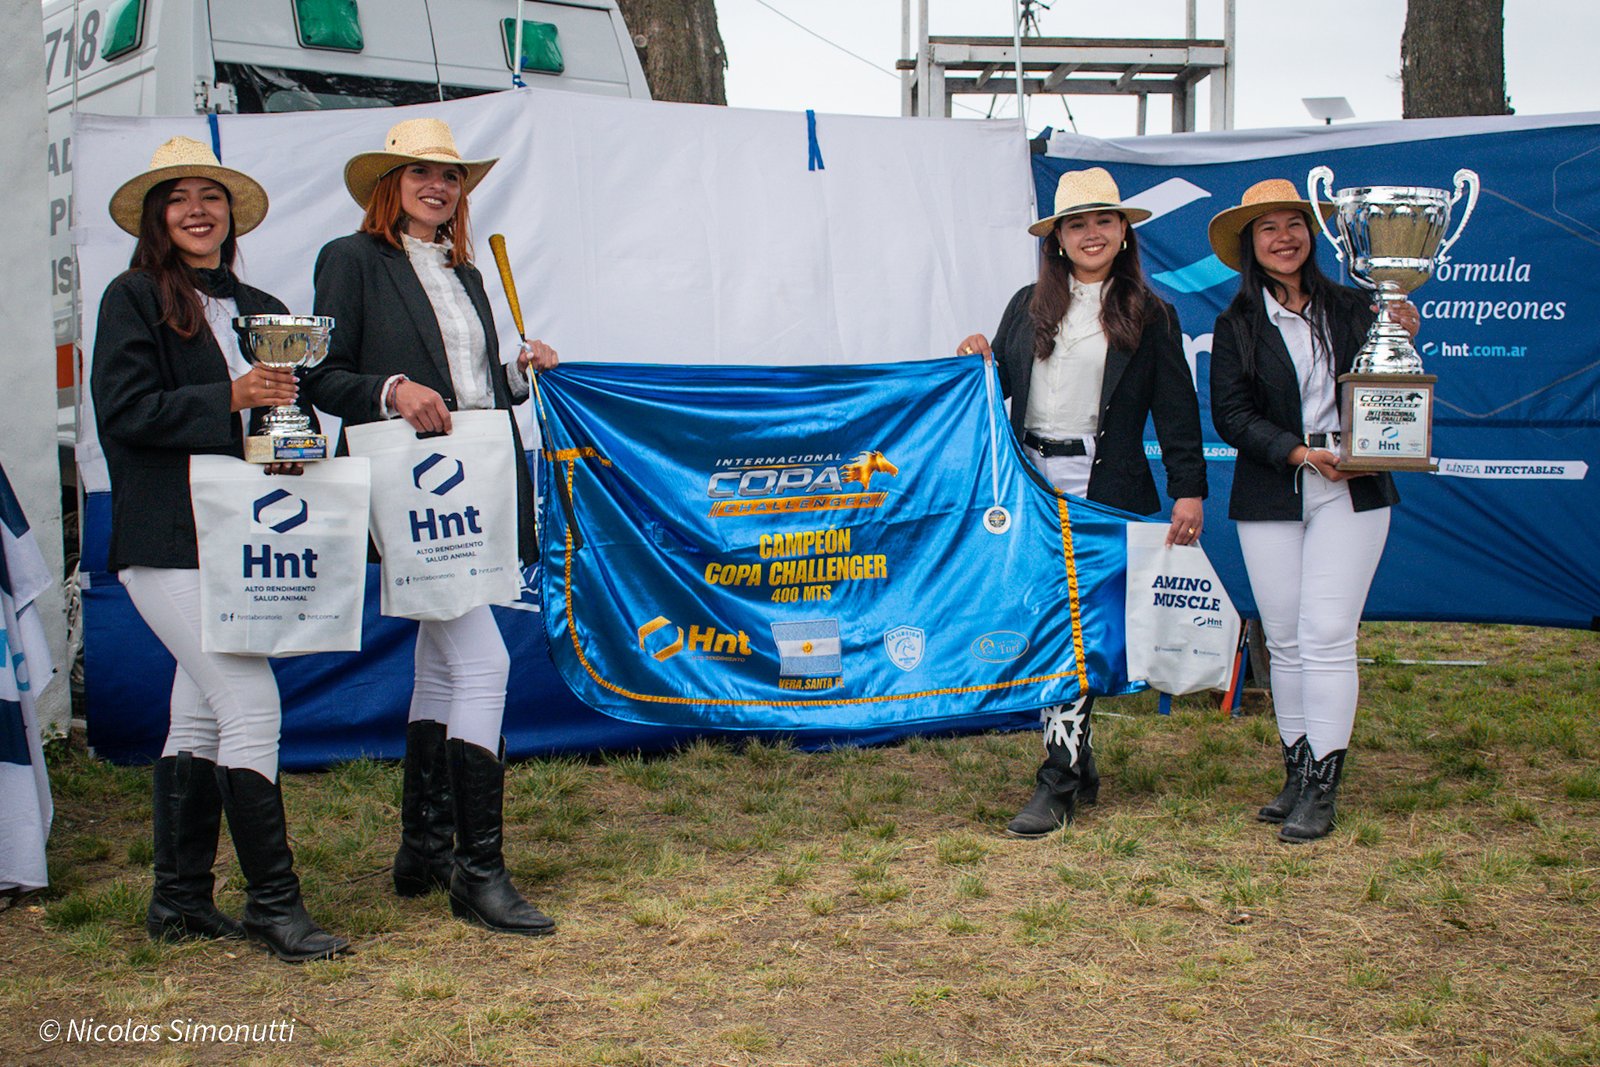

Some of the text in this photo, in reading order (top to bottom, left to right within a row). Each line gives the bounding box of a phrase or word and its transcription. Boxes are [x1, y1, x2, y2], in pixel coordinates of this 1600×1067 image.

[1436, 256, 1531, 282] órmula
[1421, 300, 1567, 326] campeones
[1441, 341, 1528, 357] hnt.com.ar
[1360, 394, 1403, 403] COPA
[1378, 440, 1401, 451] Hnt
[715, 453, 842, 467] INTERNACIONAL
[1445, 463, 1565, 475] LÍNEA INYECTABLES
[706, 466, 843, 498] COPA
[723, 496, 872, 513] CHALLENGER
[409, 505, 483, 543] Hnt
[435, 541, 484, 553] RENDIMIENTO
[758, 524, 851, 559] CAMPEÓN
[243, 544, 318, 579] Hnt
[425, 551, 477, 563] SALUD ANIMAL
[704, 554, 888, 586] COPA CHALLENGER
[1151, 575, 1212, 593] AMINO
[770, 584, 832, 603] 400 MTS
[1153, 592, 1221, 612] MUSCLE
[1207, 617, 1223, 627] Hnt
[687, 624, 752, 656] Hnt
